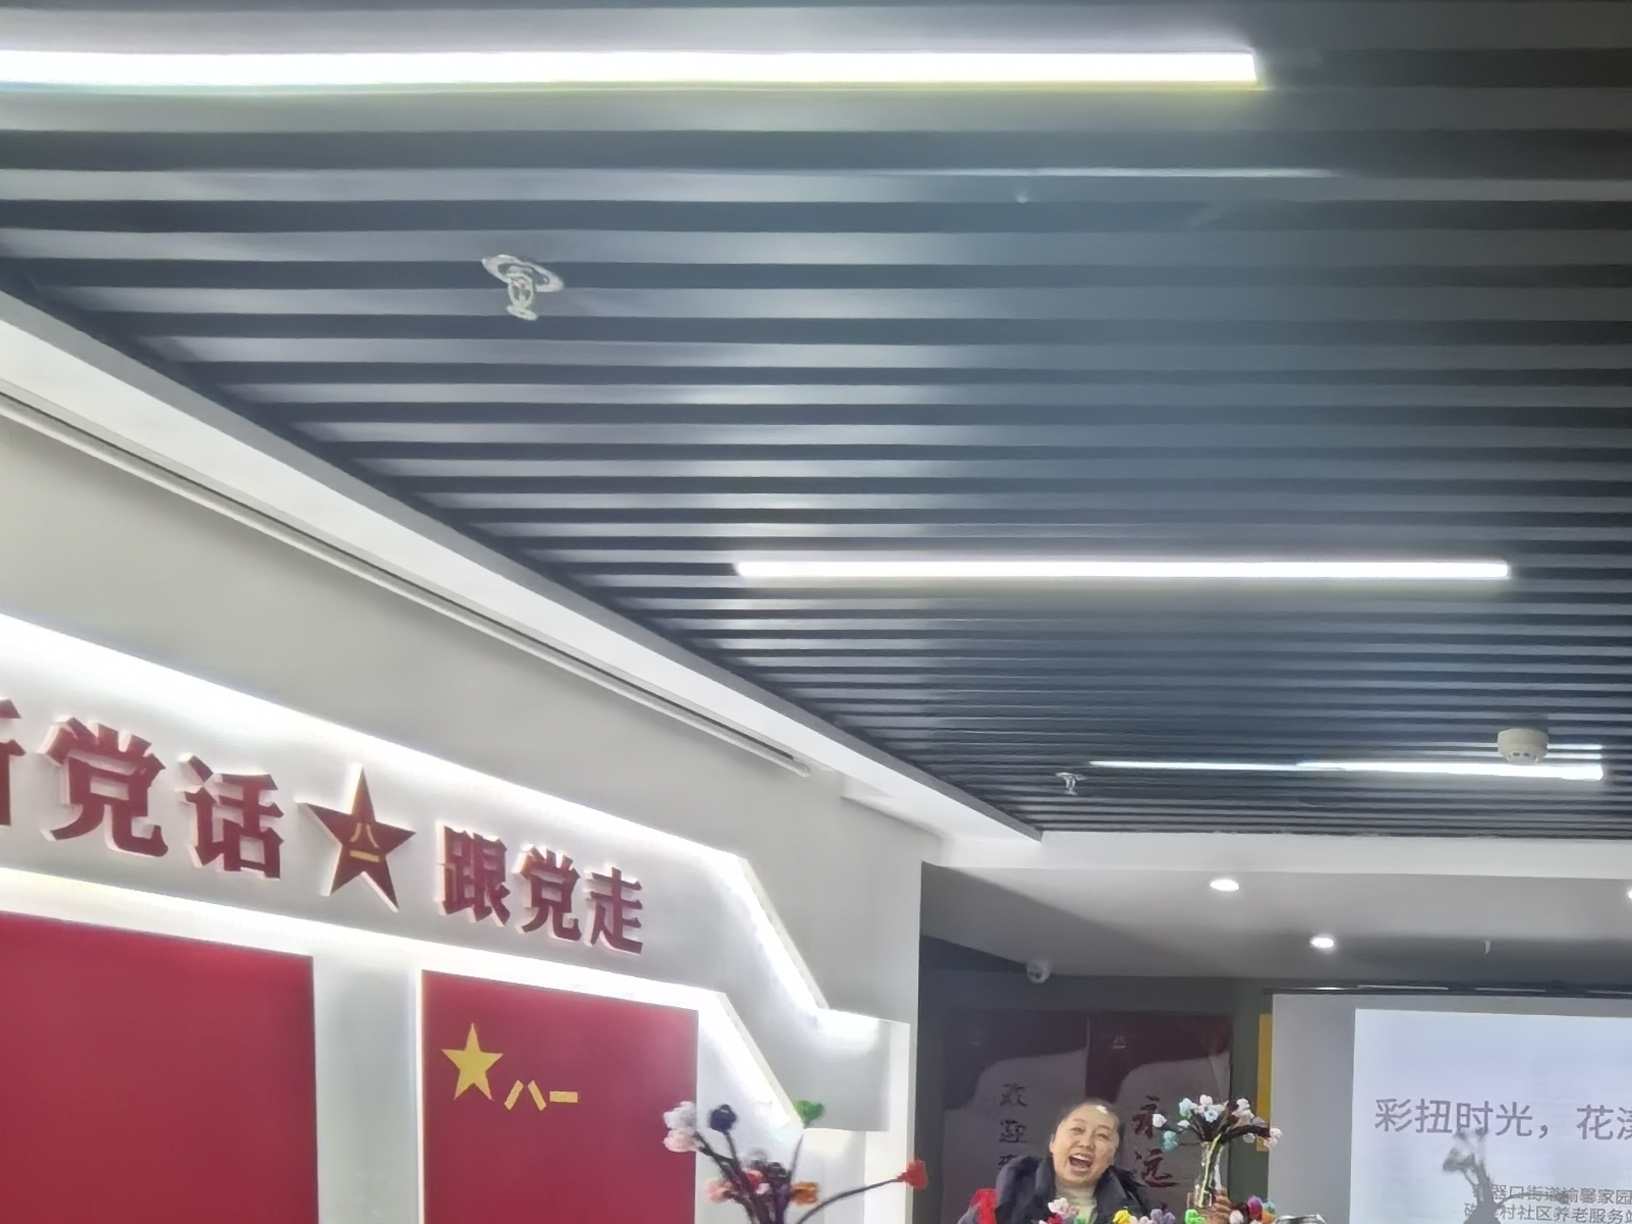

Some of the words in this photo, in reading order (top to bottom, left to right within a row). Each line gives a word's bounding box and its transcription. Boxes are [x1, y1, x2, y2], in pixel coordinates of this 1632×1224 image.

[0, 698, 284, 881] 党话
[439, 823, 644, 956] 跟党走
